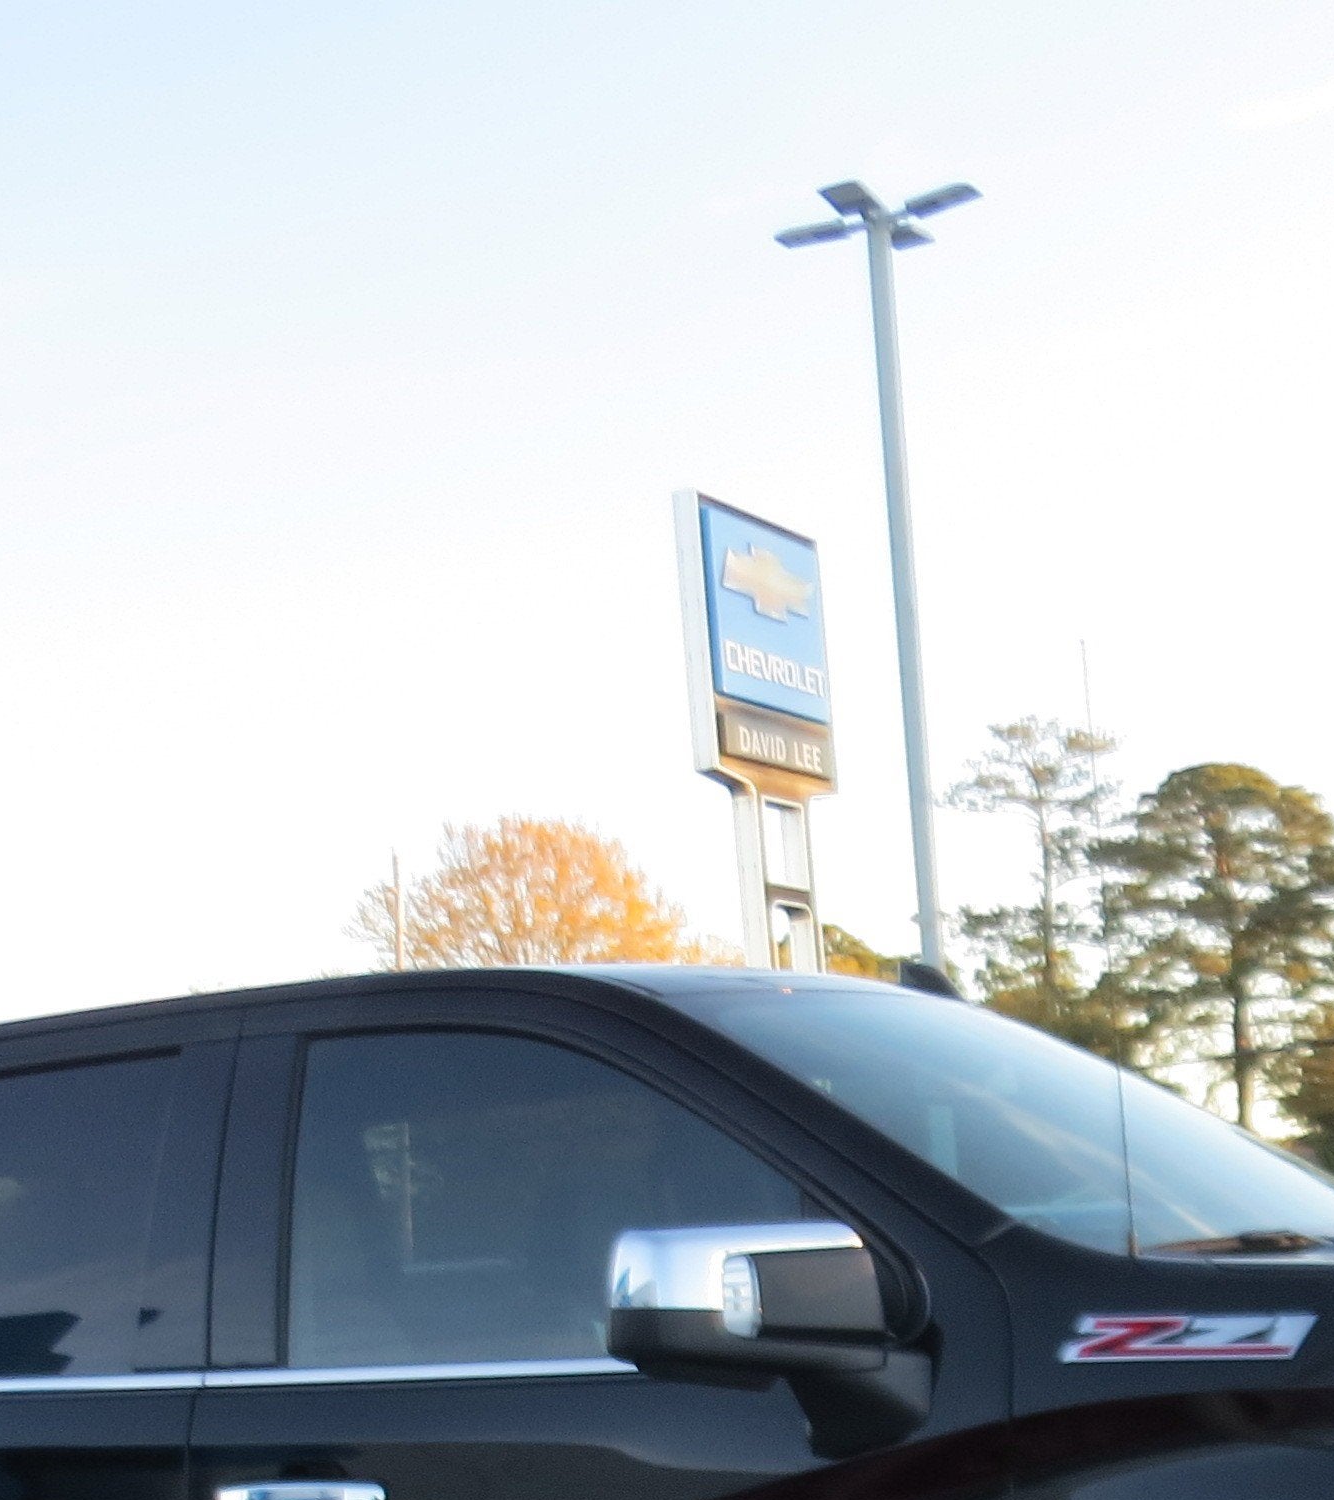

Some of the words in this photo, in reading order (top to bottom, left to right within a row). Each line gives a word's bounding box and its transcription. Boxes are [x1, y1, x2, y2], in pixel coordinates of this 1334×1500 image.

[724, 640, 825, 697] CHEVROLET
[740, 726, 786, 761] DAVID
[795, 741, 823, 773] LEE
[1060, 1315, 1317, 1361] Z71
